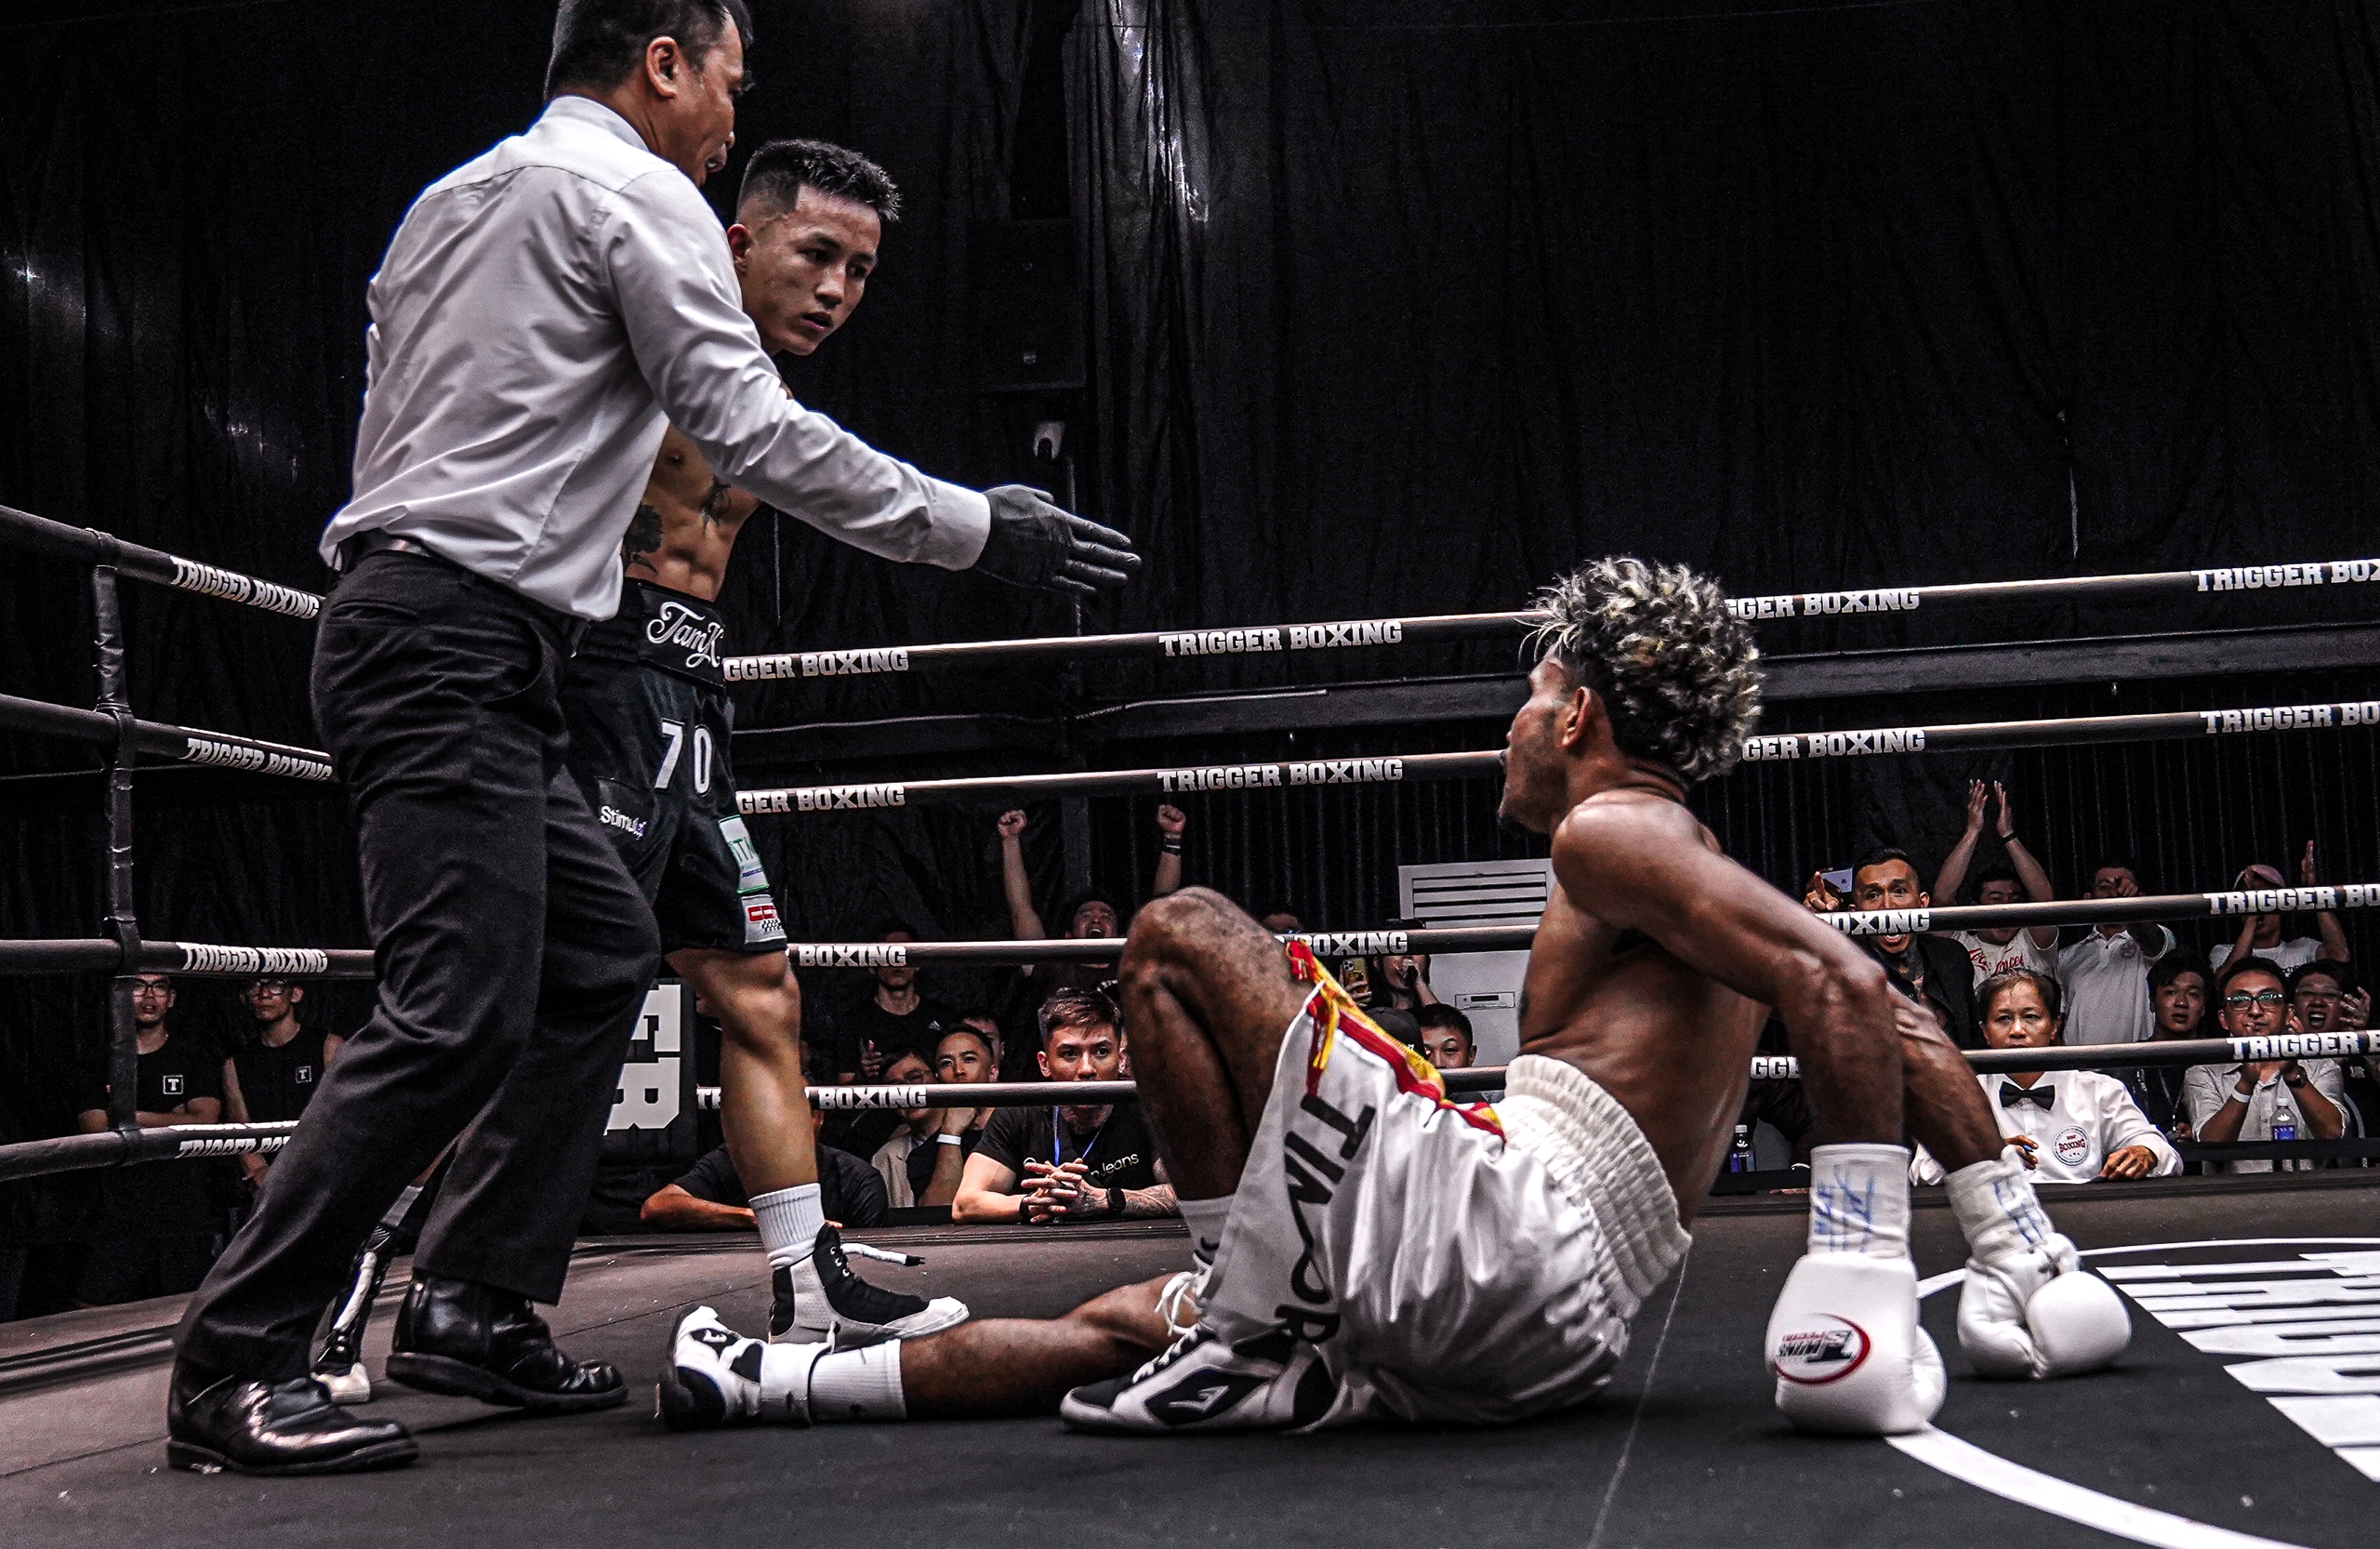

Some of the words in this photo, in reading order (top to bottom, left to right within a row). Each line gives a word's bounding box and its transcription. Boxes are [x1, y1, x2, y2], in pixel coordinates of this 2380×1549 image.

[170, 556, 251, 602] TRIGGER
[246, 579, 319, 619] BOXING
[2190, 563, 2323, 591] TRIGGER
[1725, 595, 1795, 620] GGER
[1802, 589, 1920, 616] BOXING
[1158, 628, 1282, 656] TRIGGER
[1289, 621, 1402, 649] BOXING
[723, 655, 796, 682] GGER
[800, 650, 909, 677] BOXING
[2200, 705, 2332, 734] TRIGGER
[654, 719, 712, 796] 70
[1807, 729, 1925, 758] BOXING
[1157, 764, 1281, 791] TRIGGER
[1289, 759, 1403, 785] BOXING
[797, 785, 906, 811] BOXING
[2202, 887, 2337, 915] TRIGGER
[176, 942, 259, 972] TRIGGER
[256, 947, 327, 973] BOXING
[798, 946, 906, 967] BOXING
[2226, 1032, 2360, 1060] TRIGGER
[167, 1079, 179, 1092] T
[818, 1087, 927, 1109] BOXING
[2058, 1138, 2085, 1153] BOXING
[1102, 1153, 1140, 1176] Jeans
